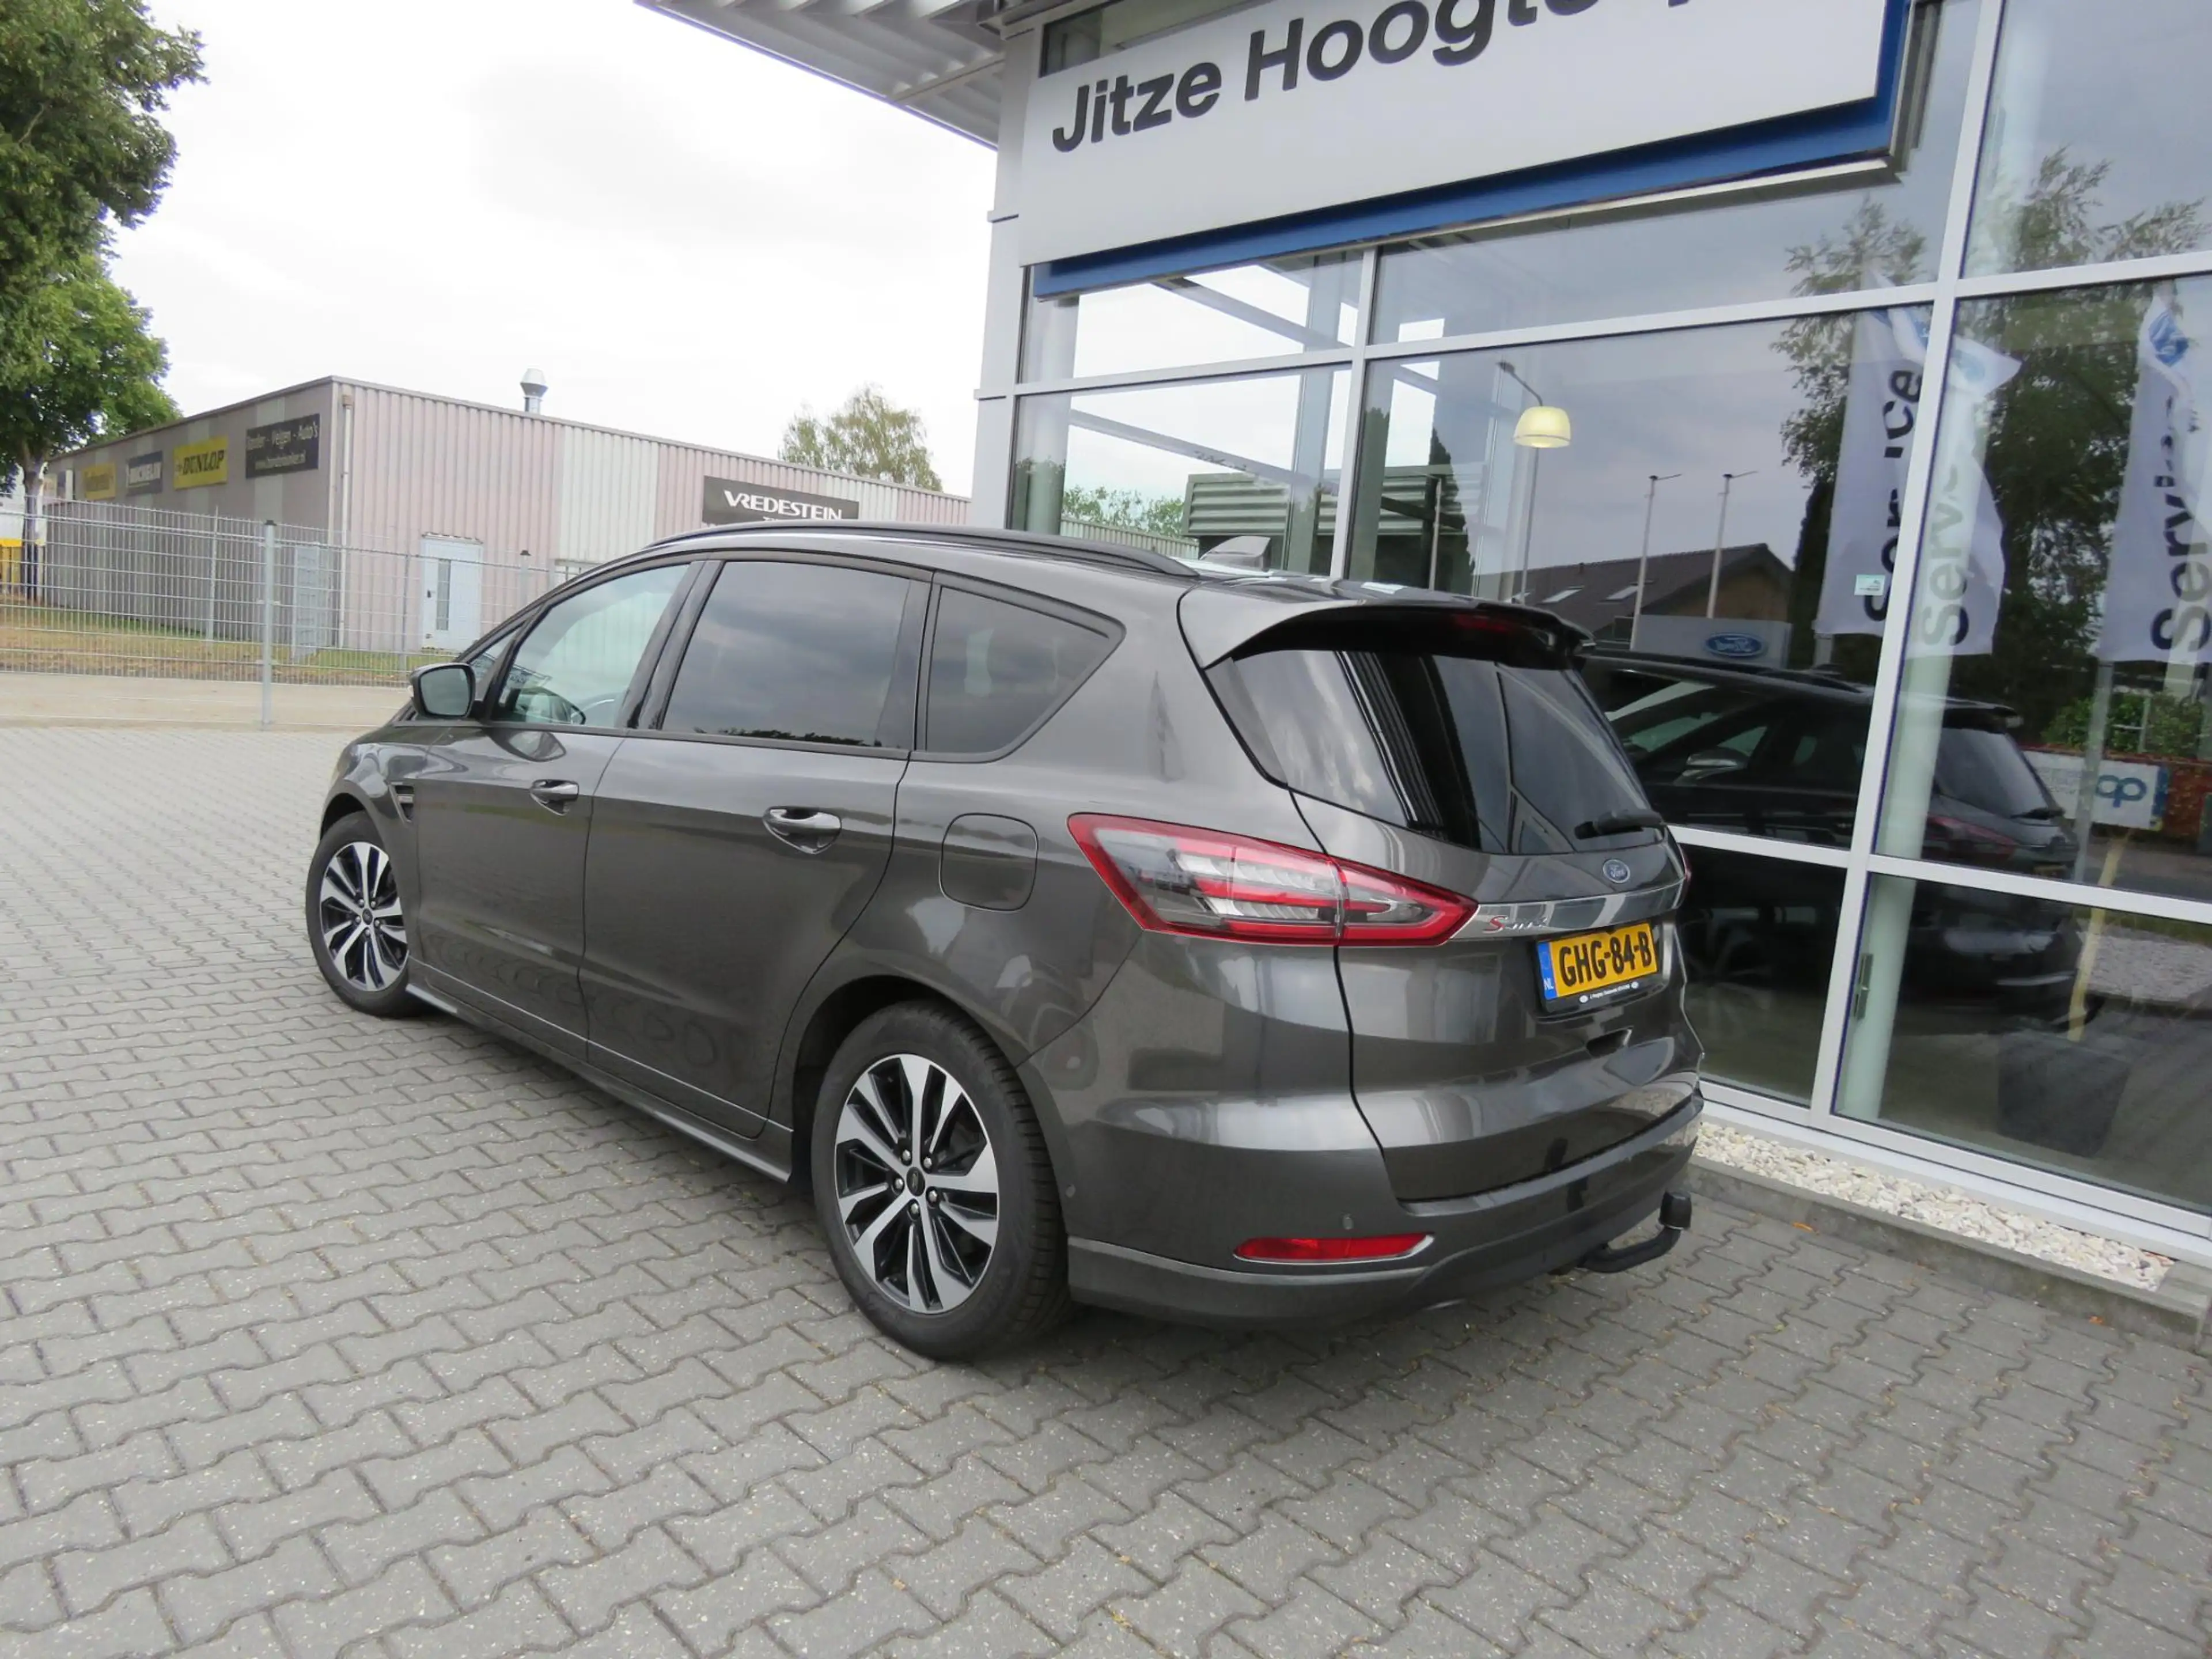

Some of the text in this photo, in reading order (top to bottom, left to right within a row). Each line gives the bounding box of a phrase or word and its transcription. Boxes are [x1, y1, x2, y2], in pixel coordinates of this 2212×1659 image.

[1051, 58, 1222, 153] Jitze
[182, 449, 225, 476] DUNLOP
[724, 489, 842, 520] VREDESTEIN
[1559, 931, 1652, 987] GHG-84-B
[1543, 977, 1555, 990] NL
